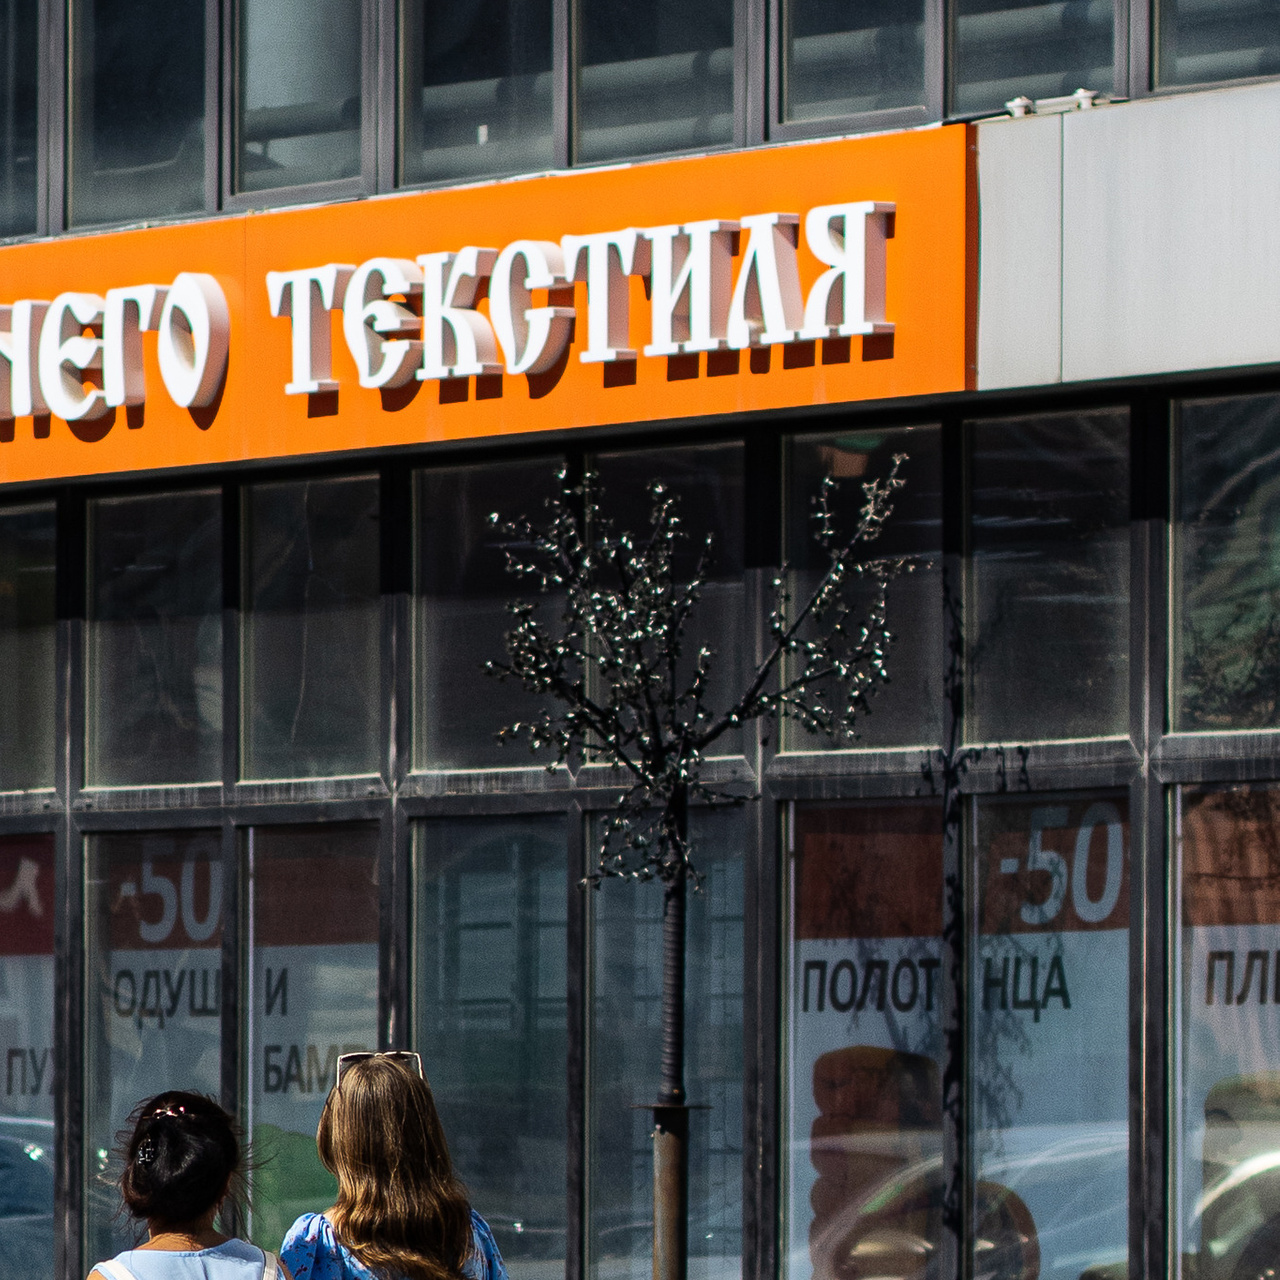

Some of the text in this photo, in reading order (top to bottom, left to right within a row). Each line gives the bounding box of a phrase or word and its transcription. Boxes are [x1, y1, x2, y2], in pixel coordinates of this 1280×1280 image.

[266, 201, 897, 396] ТЕКСТИЛЯ
[120, 835, 222, 944] -50
[999, 800, 1125, 926] -50
[6, 1046, 55, 1096] ПУ
[262, 1043, 370, 1094] БАМ
